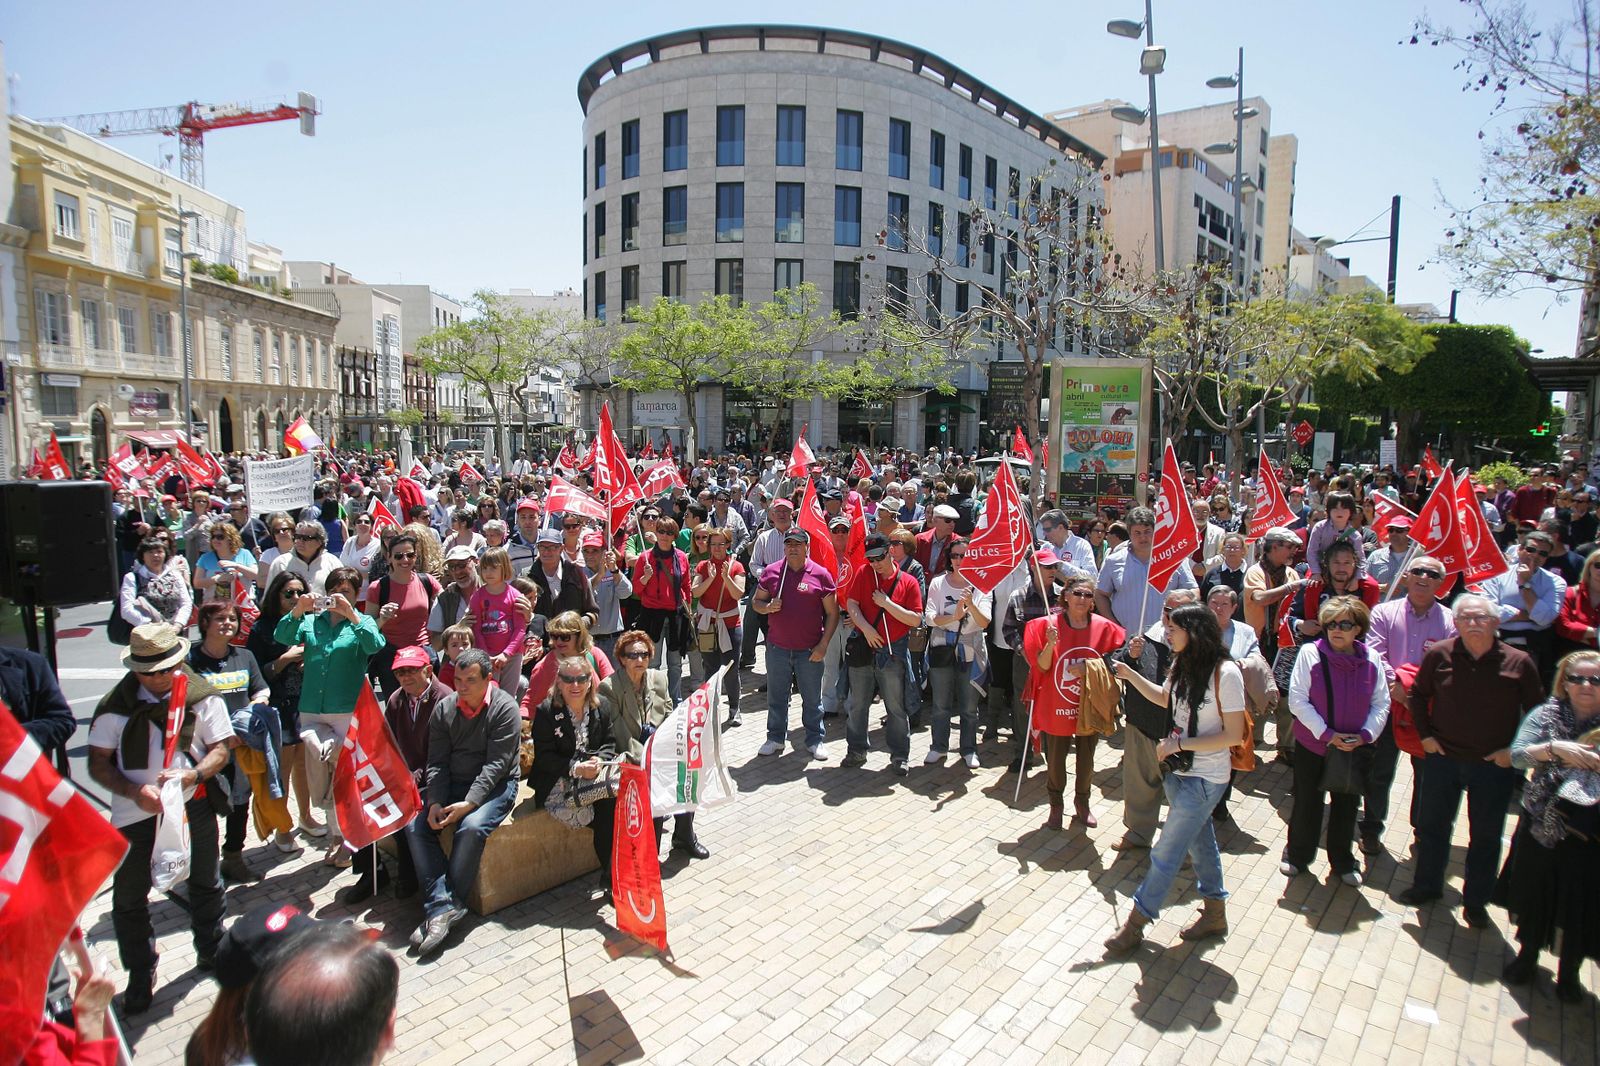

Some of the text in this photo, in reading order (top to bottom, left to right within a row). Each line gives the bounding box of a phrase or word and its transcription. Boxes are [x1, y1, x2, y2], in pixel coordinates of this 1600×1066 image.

[1066, 379, 1129, 393] Primavera
[637, 401, 677, 413] lamarca
[208, 674, 246, 685] NEM
